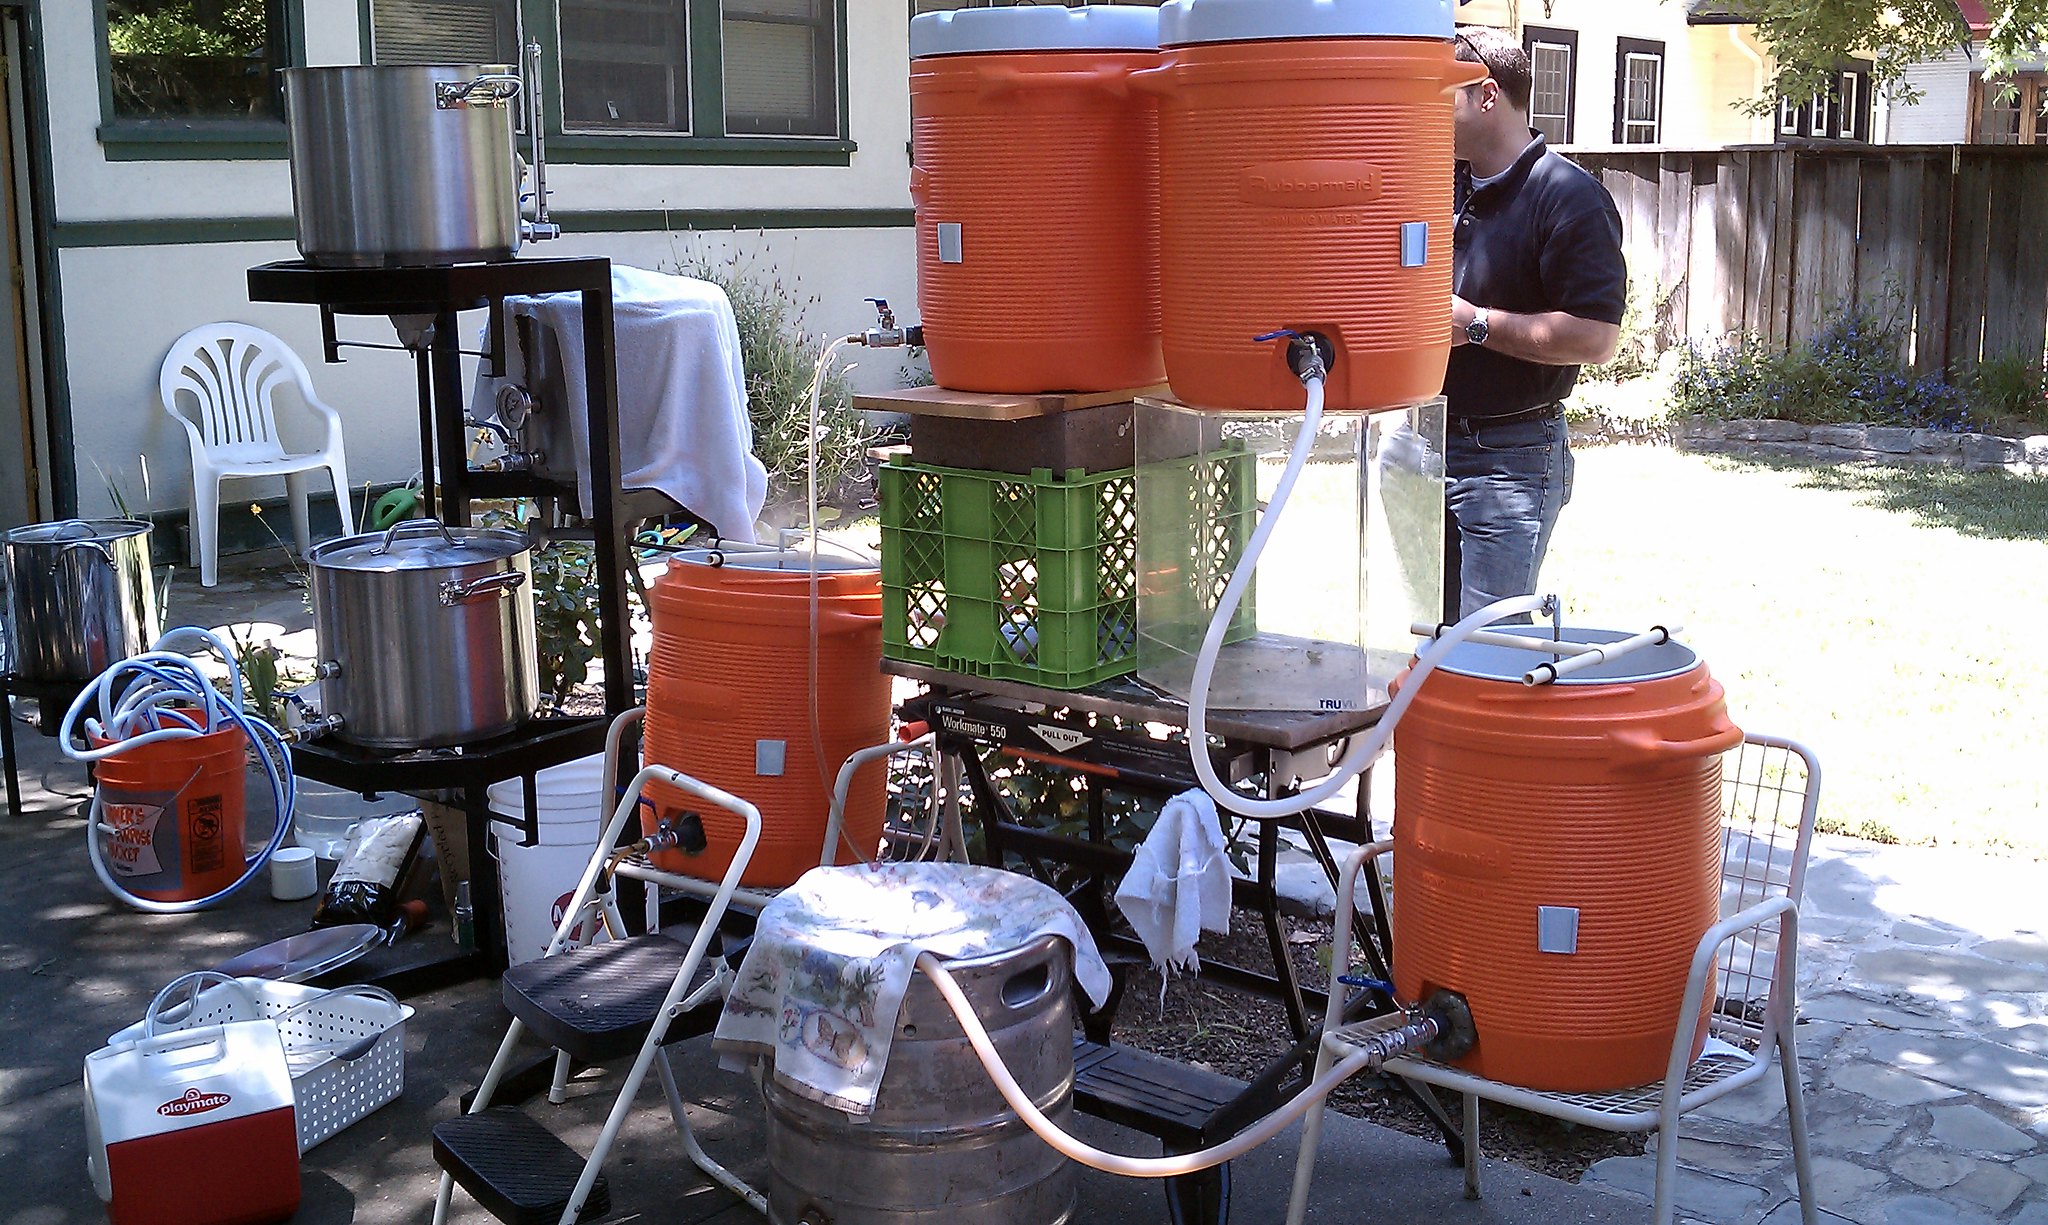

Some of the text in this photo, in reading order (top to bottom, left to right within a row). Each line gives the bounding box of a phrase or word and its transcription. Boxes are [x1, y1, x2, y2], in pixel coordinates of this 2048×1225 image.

[1250, 172, 1374, 193] Rubbermaid
[942, 715, 1007, 739] Workmate 550
[1042, 730, 1079, 743] PULL OUT
[160, 1095, 229, 1116] playmate
